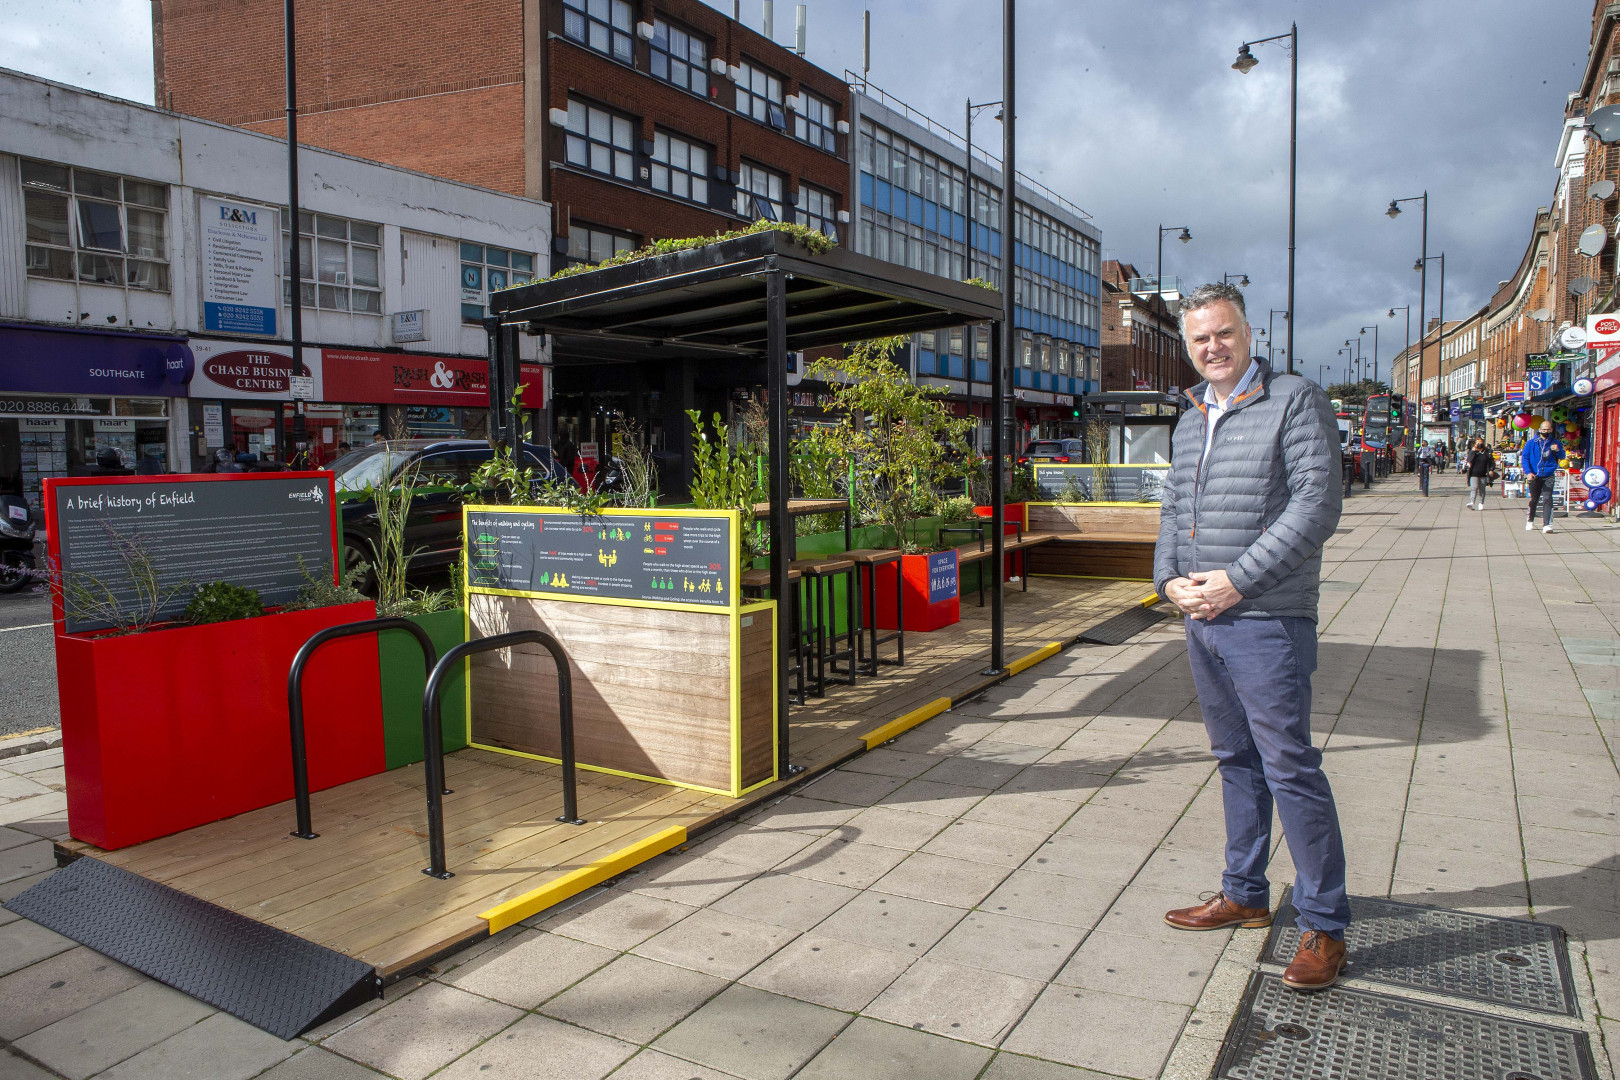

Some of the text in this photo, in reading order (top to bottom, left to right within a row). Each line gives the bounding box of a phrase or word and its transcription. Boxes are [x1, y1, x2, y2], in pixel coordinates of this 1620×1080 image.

[220, 206, 256, 224] E&M
[220, 222, 258, 232] SOLICITORS
[237, 254, 263, 262] Conveyancing
[468, 273, 474, 282] N
[400, 312, 416, 323] E&M
[166, 357, 184, 370] haart
[247, 354, 270, 364] THE
[89, 368, 145, 379] SOUTHGATE
[209, 364, 249, 376] CHASE
[253, 368, 306, 378] BUSINES
[393, 361, 486, 390] RASH & RASH
[236, 378, 282, 389] CENTRE
[1531, 376, 1541, 390] S
[0, 401, 93, 413] 020 8886 4444
[67, 491, 195, 512] A brief history of Enfield
[479, 519, 492, 527] benefits
[493, 519, 497, 527] of
[498, 520, 512, 528] walking
[521, 520, 534, 530] cycling
